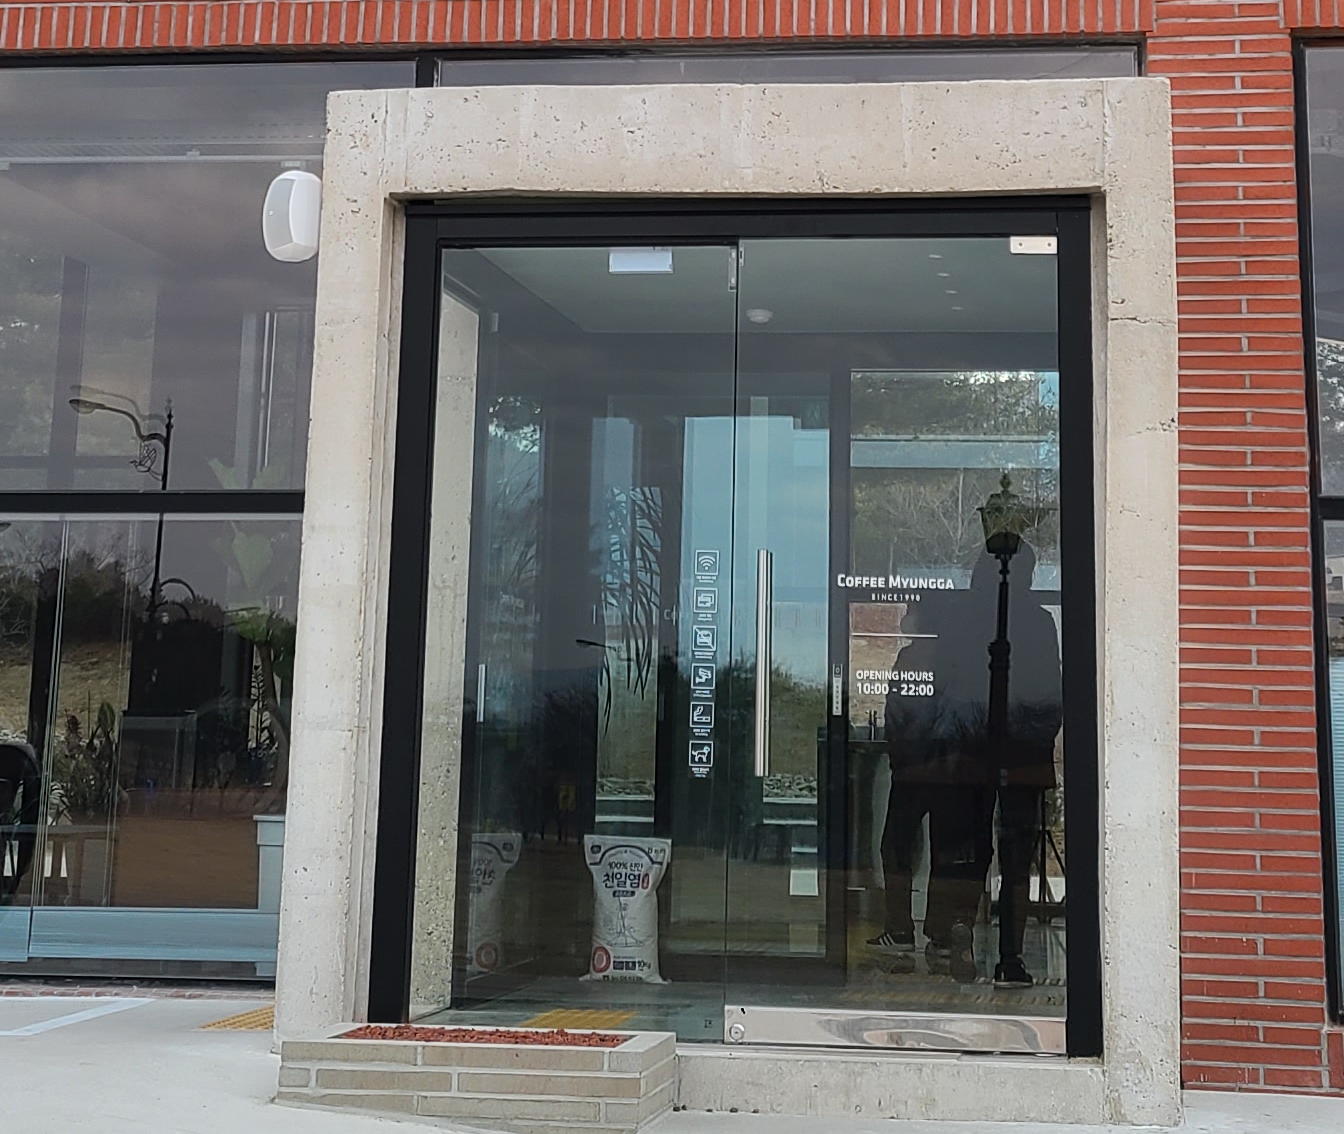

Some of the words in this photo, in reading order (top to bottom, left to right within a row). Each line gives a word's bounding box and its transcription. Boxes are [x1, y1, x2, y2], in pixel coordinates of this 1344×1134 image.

[837, 574, 886, 588] COFFEE
[888, 575, 955, 590] MYUNGGA
[856, 670, 899, 681] OPENING
[900, 670, 934, 682] HOURS
[856, 683, 890, 695] 10:00
[900, 684, 934, 696] 22:00
[602, 871, 641, 889] 천일염
